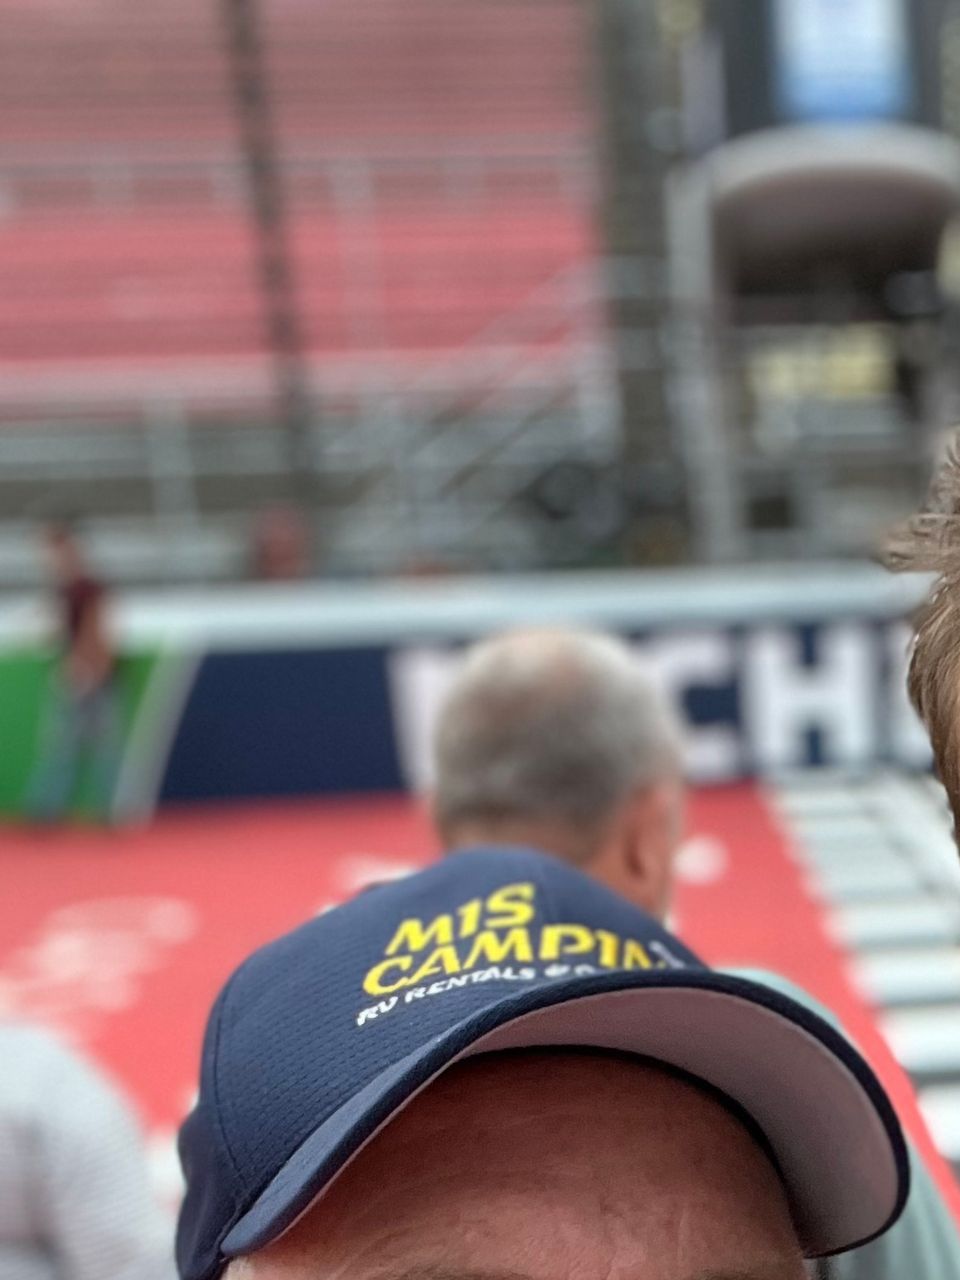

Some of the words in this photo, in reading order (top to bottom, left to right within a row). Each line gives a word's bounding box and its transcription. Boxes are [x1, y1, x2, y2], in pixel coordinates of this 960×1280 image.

[362, 923, 667, 996] CAMPIN
[356, 996, 399, 1026] RV
[404, 965, 536, 1003] RENTALS
